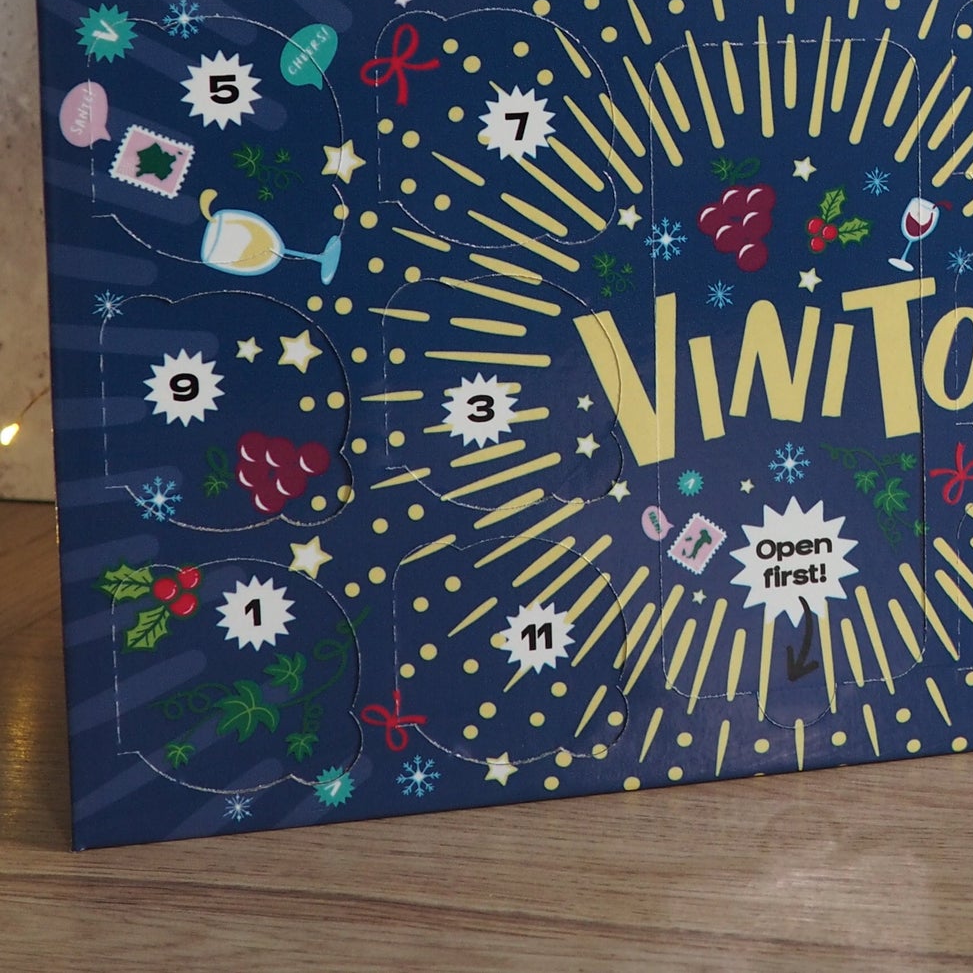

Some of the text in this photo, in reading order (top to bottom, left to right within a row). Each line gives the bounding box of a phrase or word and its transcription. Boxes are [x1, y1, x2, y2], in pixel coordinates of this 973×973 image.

[209, 75, 239, 104] 5
[505, 112, 529, 141] 7
[169, 372, 200, 402] 9
[467, 394, 495, 423] 3
[756, 536, 833, 561] Open
[763, 563, 828, 589] first!
[245, 599, 263, 627] 1
[521, 623, 554, 651] 11
